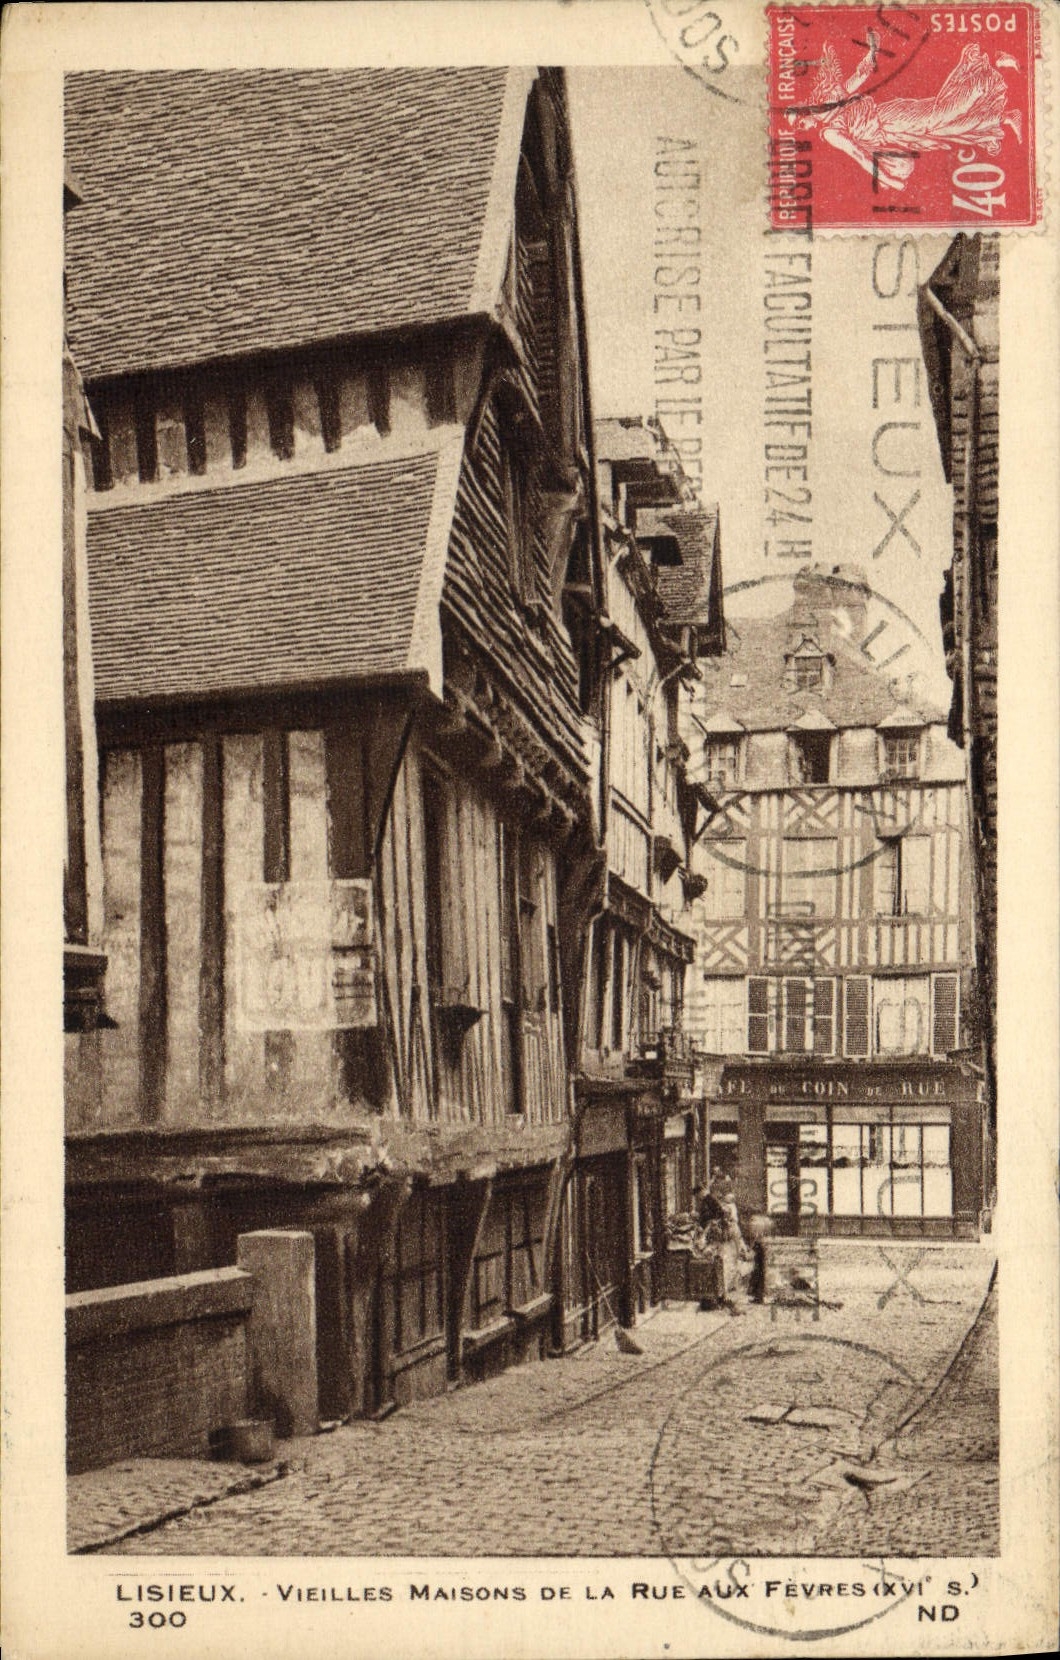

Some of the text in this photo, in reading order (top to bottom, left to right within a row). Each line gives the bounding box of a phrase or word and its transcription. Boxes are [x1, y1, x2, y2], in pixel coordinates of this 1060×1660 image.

[930, 12, 1017, 33] POSTES
[777, 15, 796, 100] FRANÇAISE
[802, 1080, 849, 1096] COIN
[901, 1080, 946, 1096] RUE
